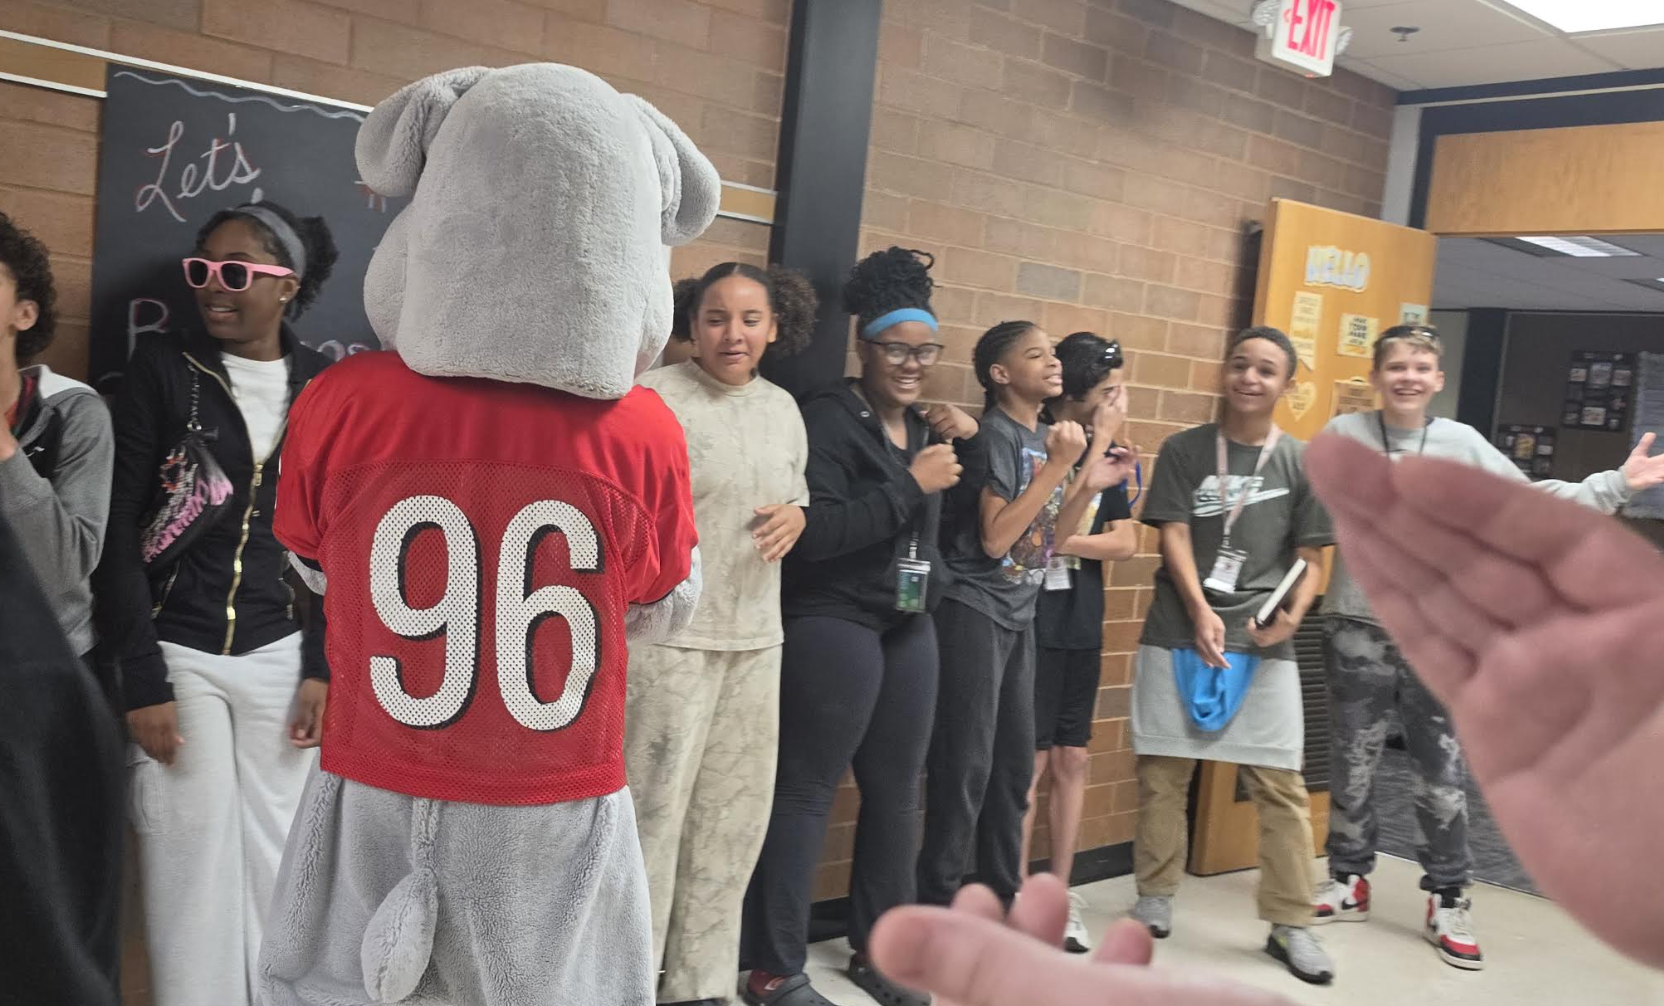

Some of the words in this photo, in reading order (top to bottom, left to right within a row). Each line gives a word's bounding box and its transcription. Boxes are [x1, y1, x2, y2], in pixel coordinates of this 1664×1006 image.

[1286, 0, 1336, 61] EXIT
[135, 112, 261, 222] Let's
[1305, 246, 1370, 292] HELLO
[369, 494, 605, 731] 96
